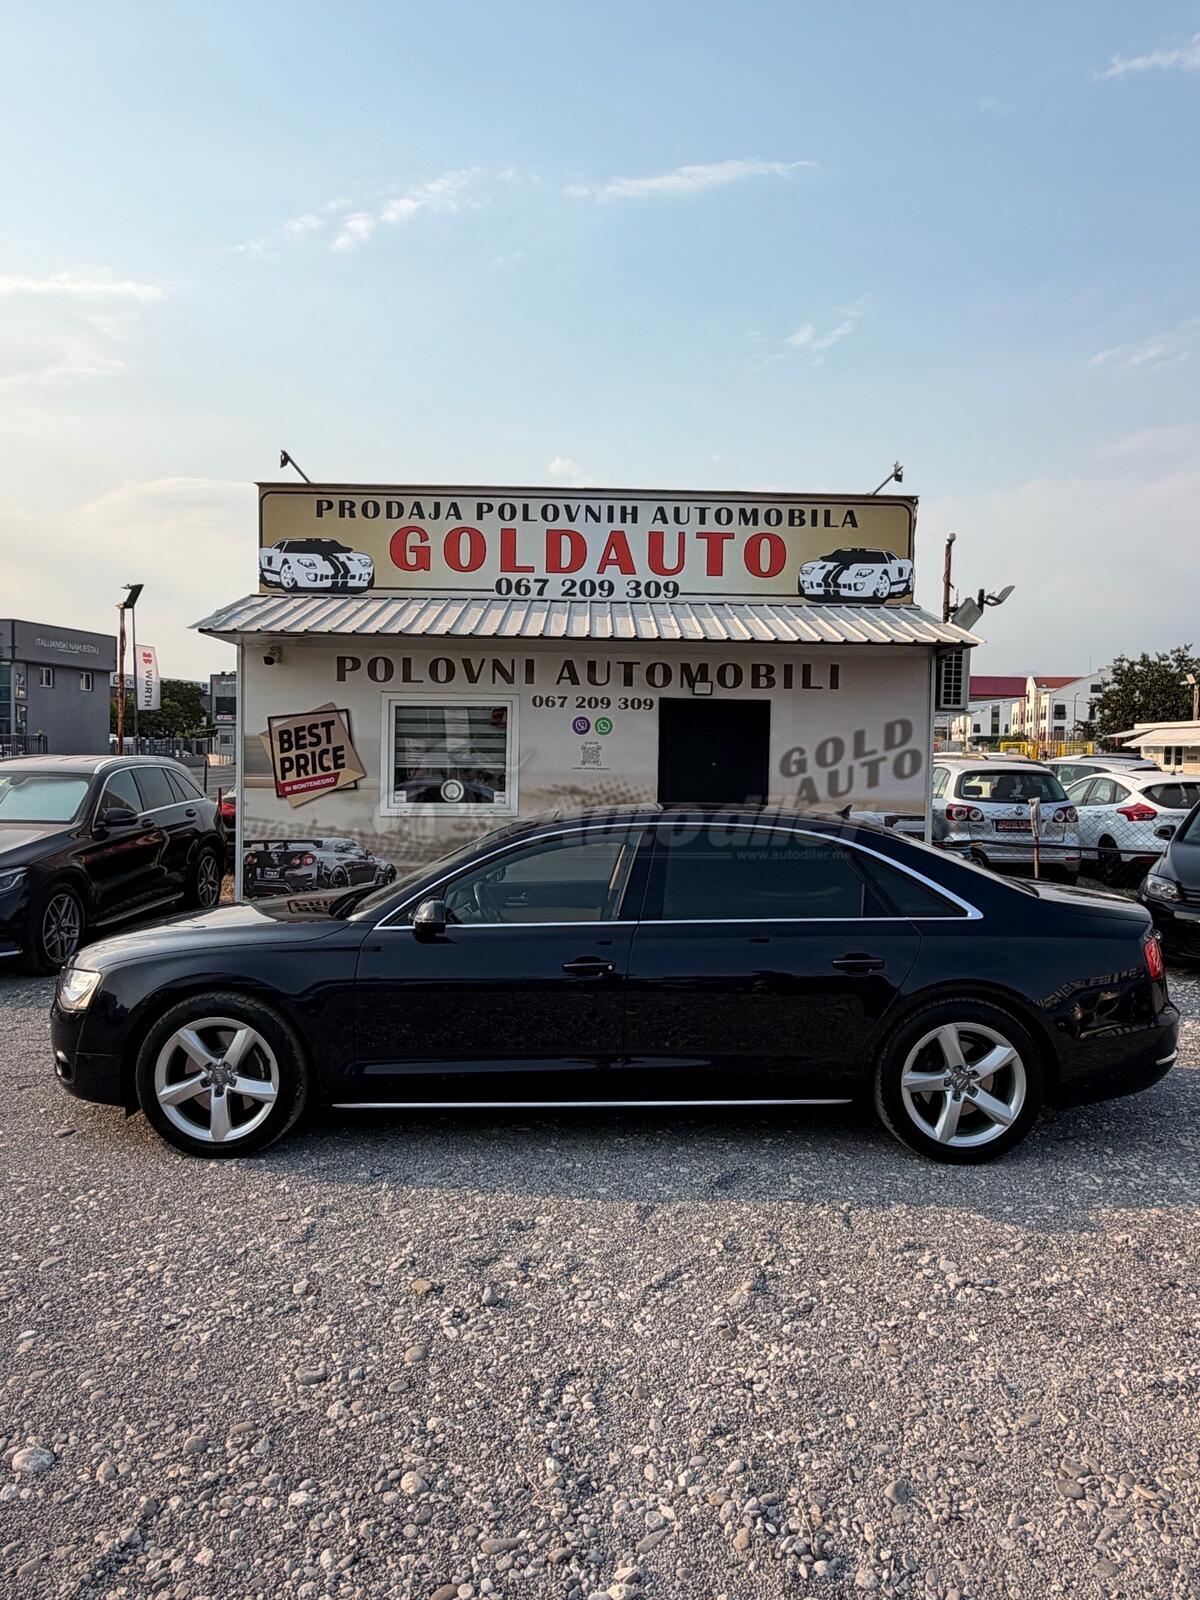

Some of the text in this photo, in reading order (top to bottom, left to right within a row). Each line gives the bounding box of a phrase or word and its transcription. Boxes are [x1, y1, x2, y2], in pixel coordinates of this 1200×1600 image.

[316, 499, 859, 528] PRODAJA POLOVNIH AUTOMOBILA
[389, 525, 787, 578] GOLDAUTO
[494, 577, 680, 599] 067 209 309
[336, 656, 840, 690] POLOVNI AUTOMOBILI
[531, 694, 654, 711] 067 209 309
[278, 719, 336, 754] BEST
[779, 717, 913, 778] GOLD
[279, 744, 346, 781] PRICE
[795, 748, 923, 806] AUTO
[284, 776, 335, 793] IN MONTENEGRO
